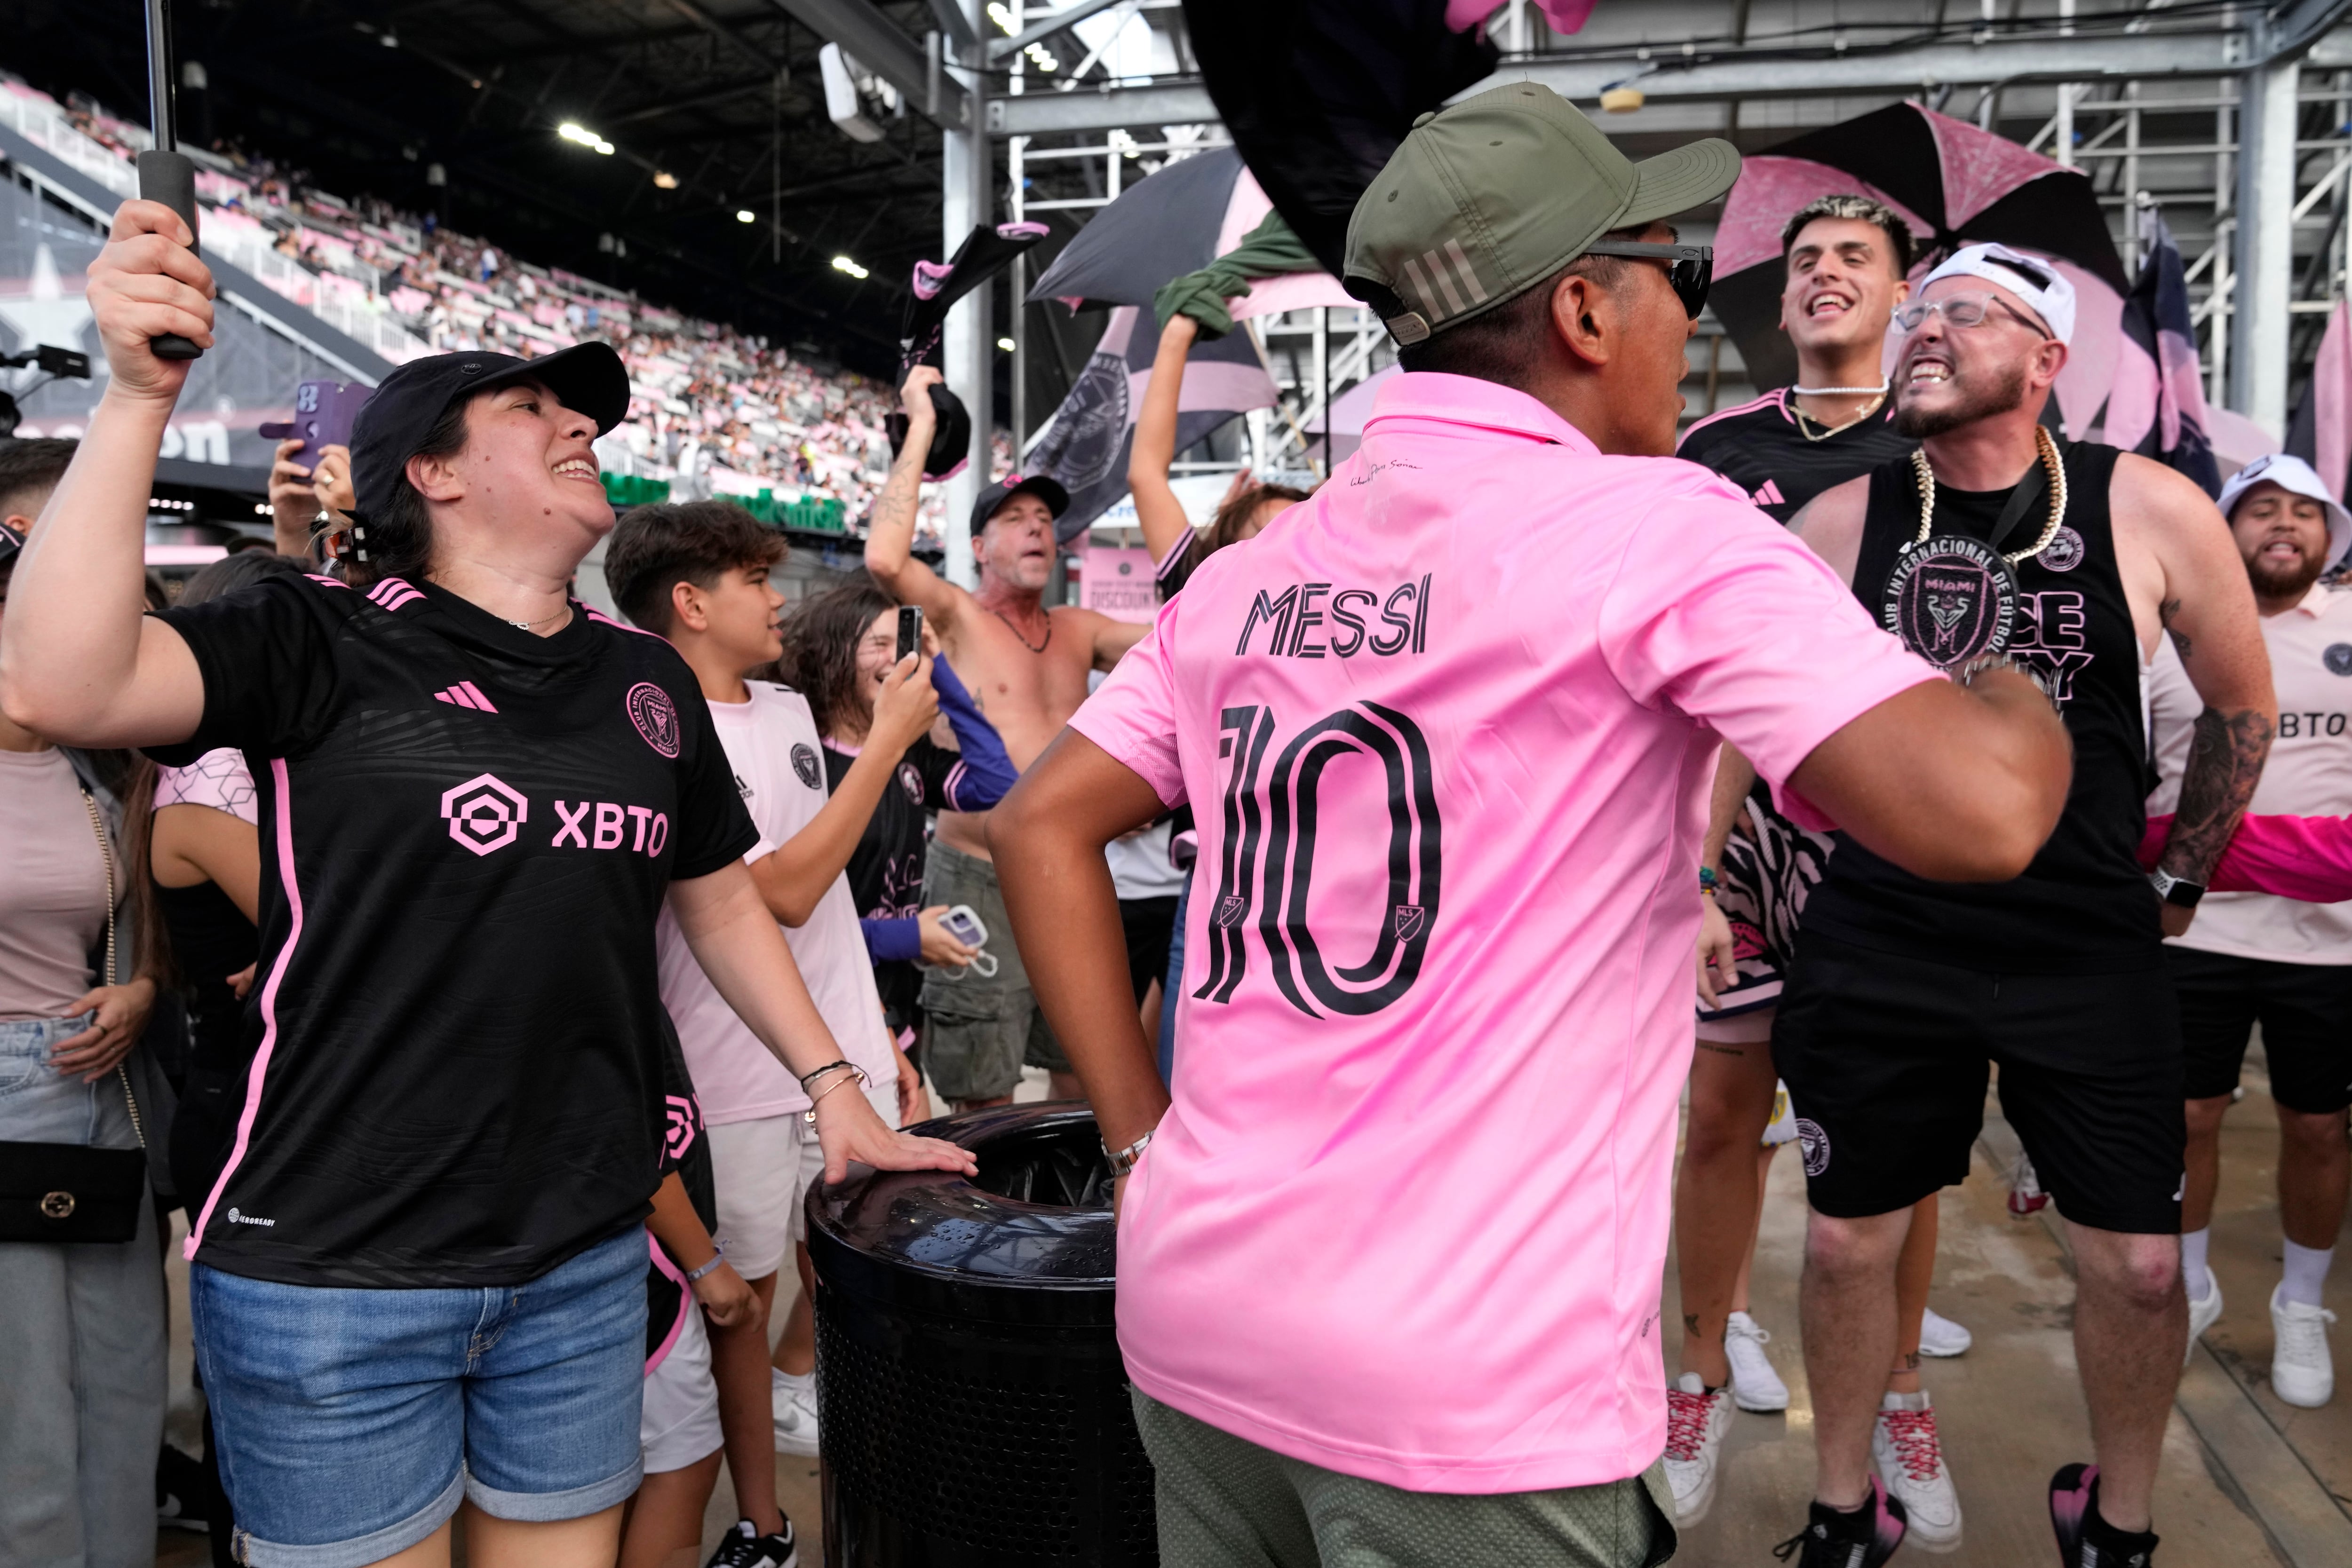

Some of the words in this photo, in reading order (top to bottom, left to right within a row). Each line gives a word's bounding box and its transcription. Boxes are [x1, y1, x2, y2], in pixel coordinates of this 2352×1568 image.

[1887, 539, 1994, 595] INTERNACIONAL
[1992, 571, 2010, 594] DE
[1925, 579, 1976, 593] MIAMI
[1235, 572, 1432, 658] MESSI
[2279, 712, 2346, 738] BTO
[551, 800, 668, 858] XBTO
[1192, 700, 1441, 1020] 10
[1398, 908, 1413, 917] MLS
[238, 1215, 276, 1227] AEROREADY
